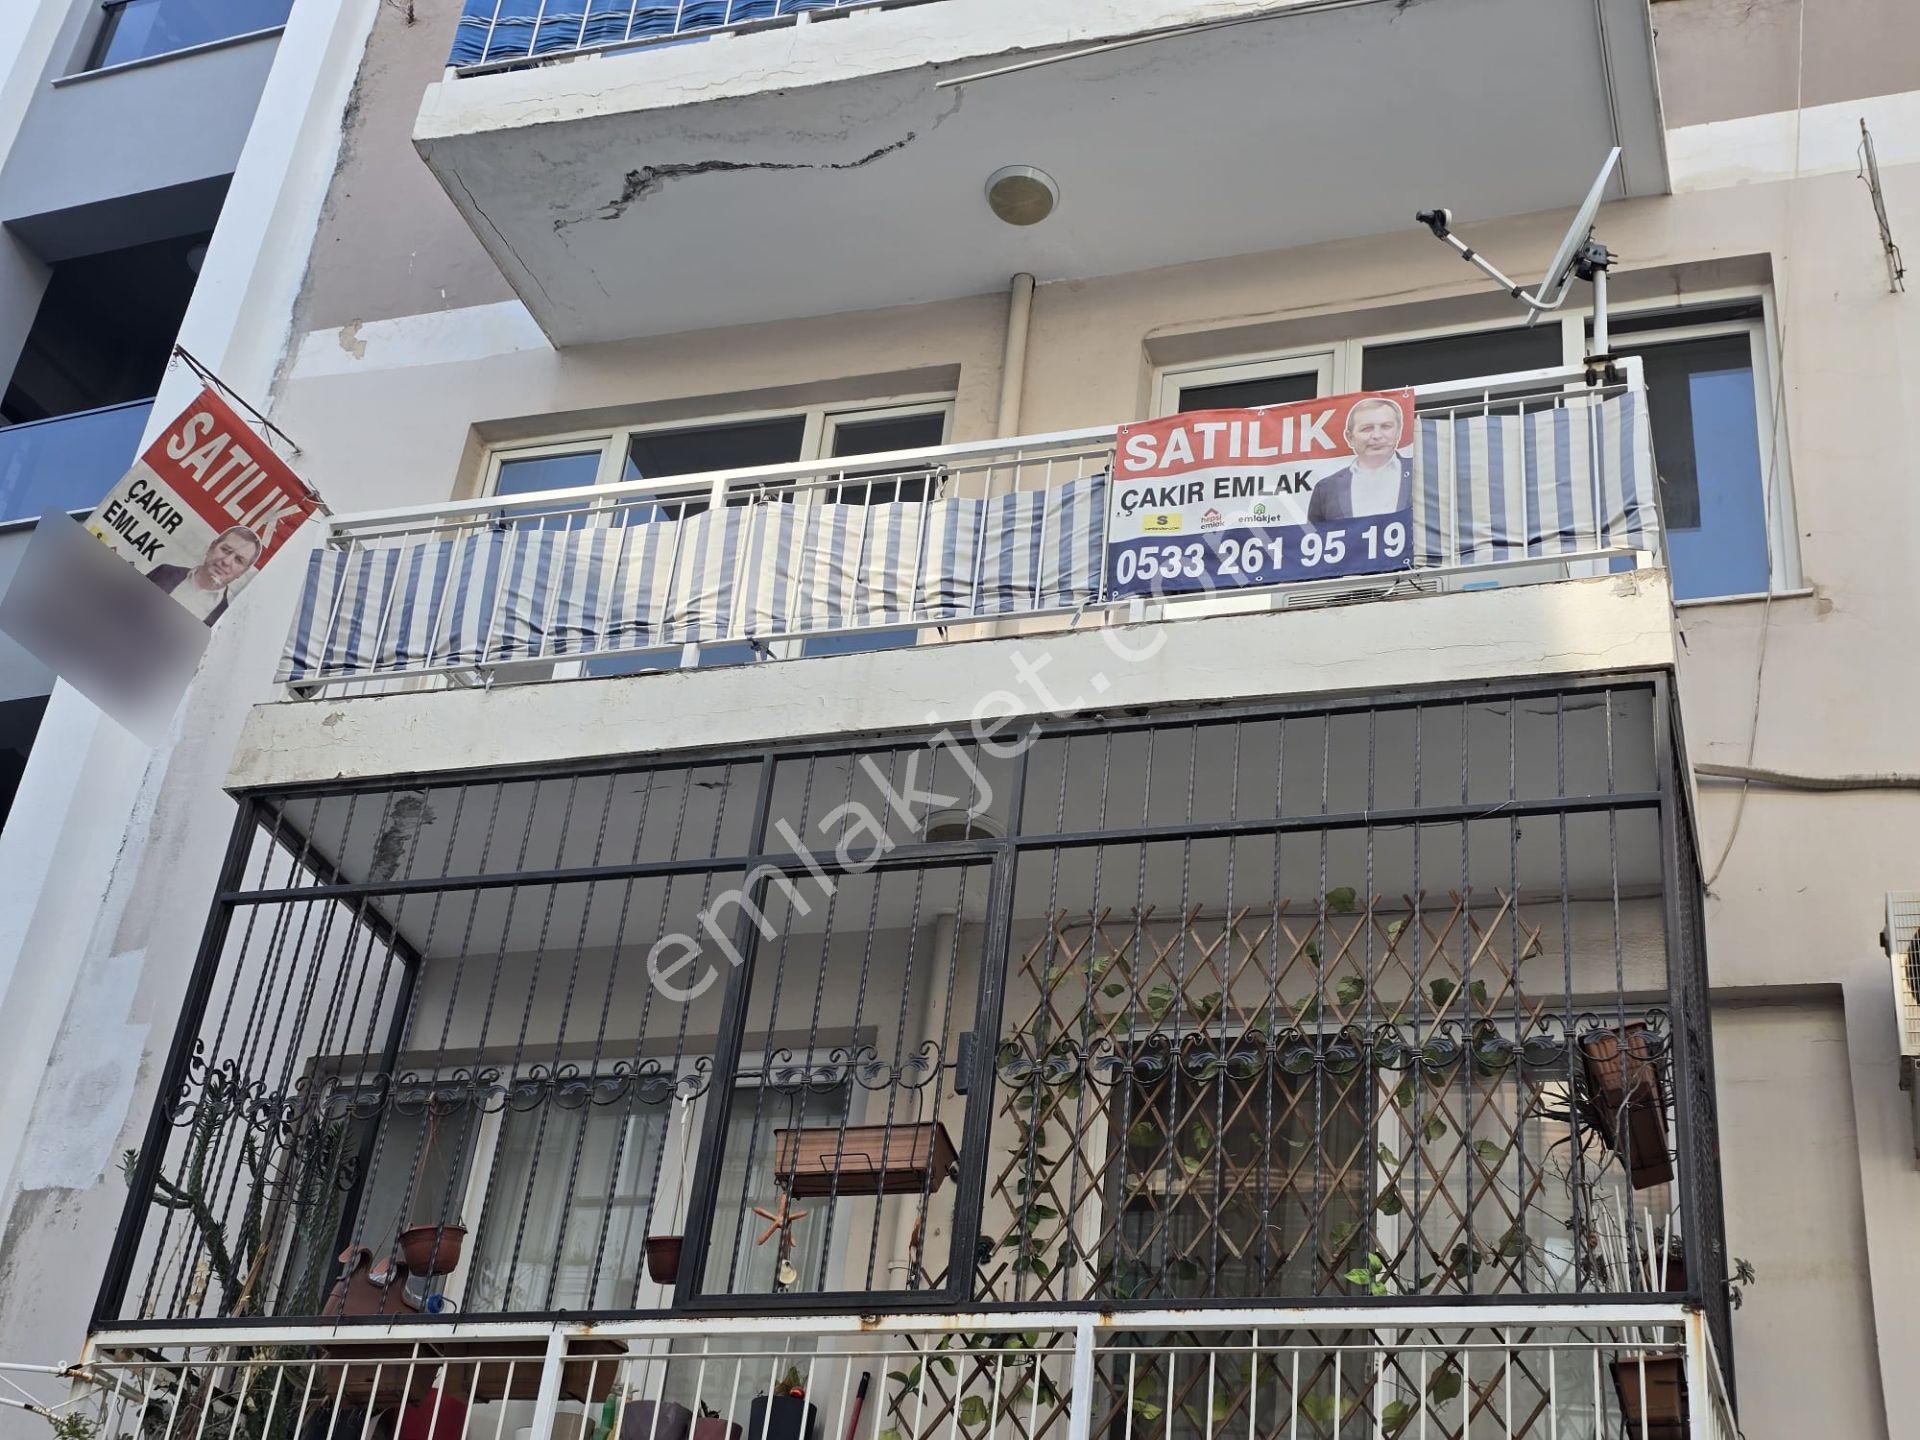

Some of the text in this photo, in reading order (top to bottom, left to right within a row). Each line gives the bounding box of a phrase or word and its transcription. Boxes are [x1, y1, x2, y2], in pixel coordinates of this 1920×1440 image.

[1123, 409, 1337, 471] SATILIK
[124, 479, 183, 535] ÇAKIR
[166, 411, 301, 548] SATILIK
[1120, 470, 1312, 516] ÇAKIR EMLAK
[102, 499, 165, 562] EMLAK
[1238, 514, 1281, 524] emlakjet
[1116, 521, 1406, 586] 0533 261 95 19
